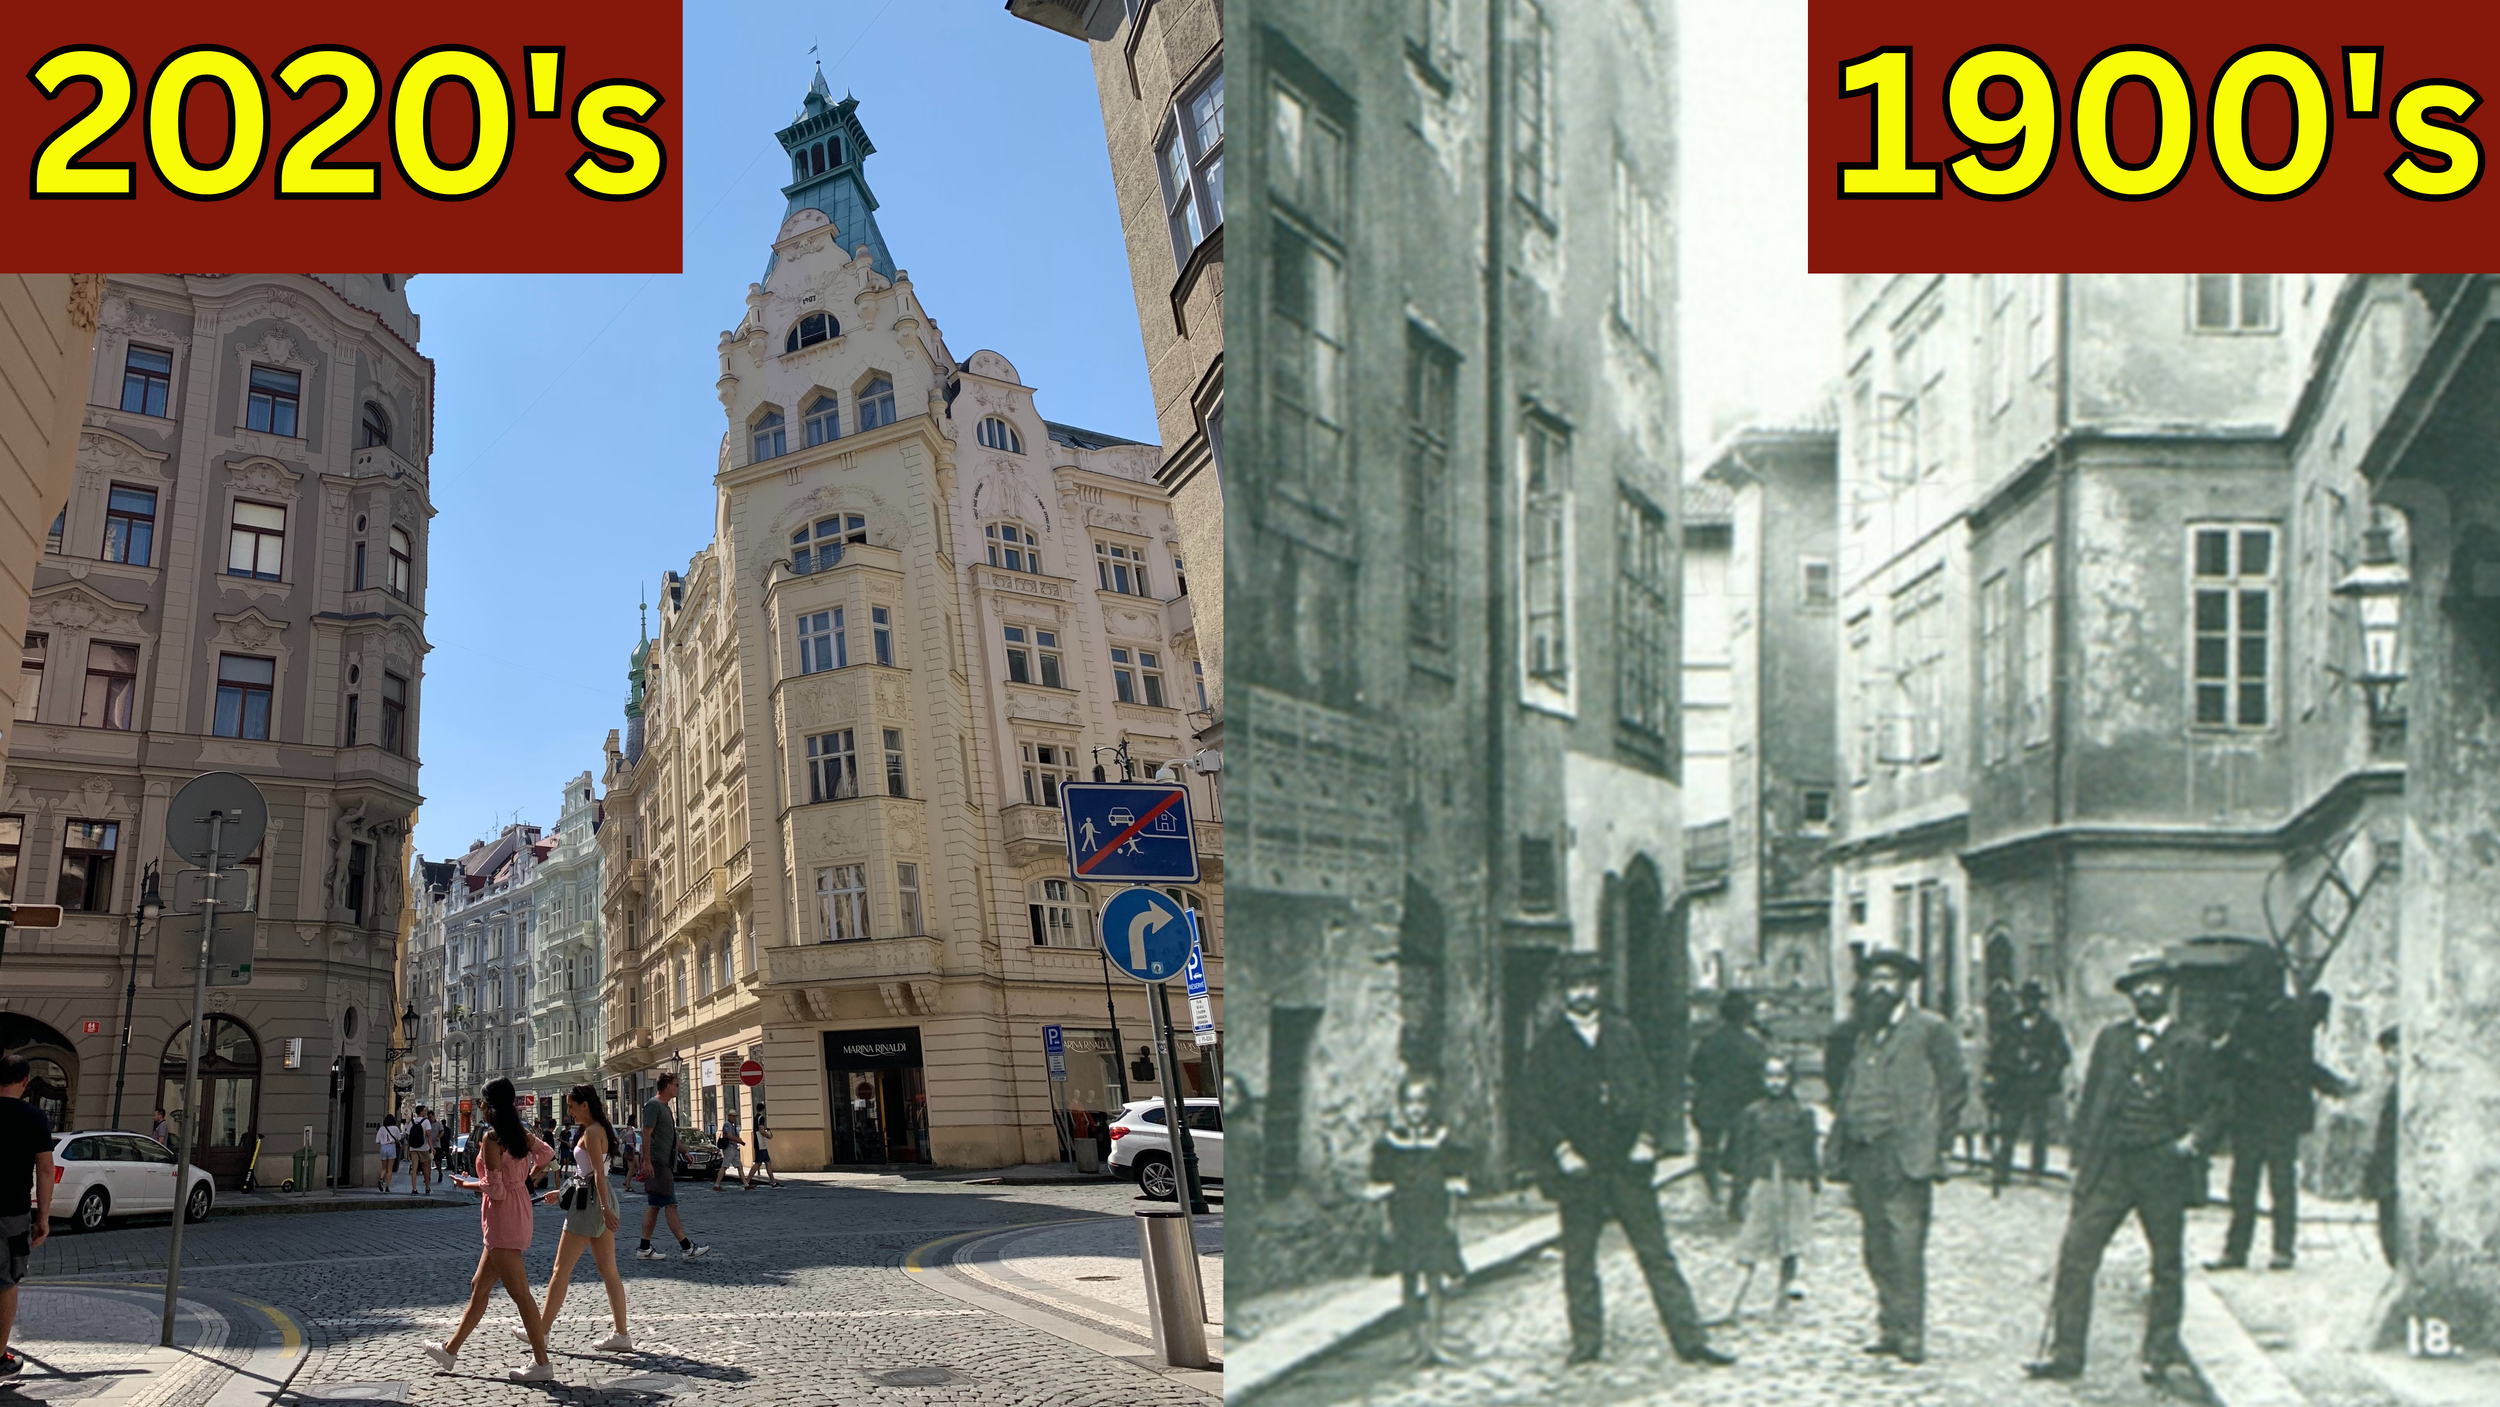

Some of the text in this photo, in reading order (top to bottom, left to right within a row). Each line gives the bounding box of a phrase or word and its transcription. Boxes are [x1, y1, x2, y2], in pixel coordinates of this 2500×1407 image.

[1048, 1028, 1059, 1045] P
[843, 1043, 907, 1056] MARINA RINALDI
